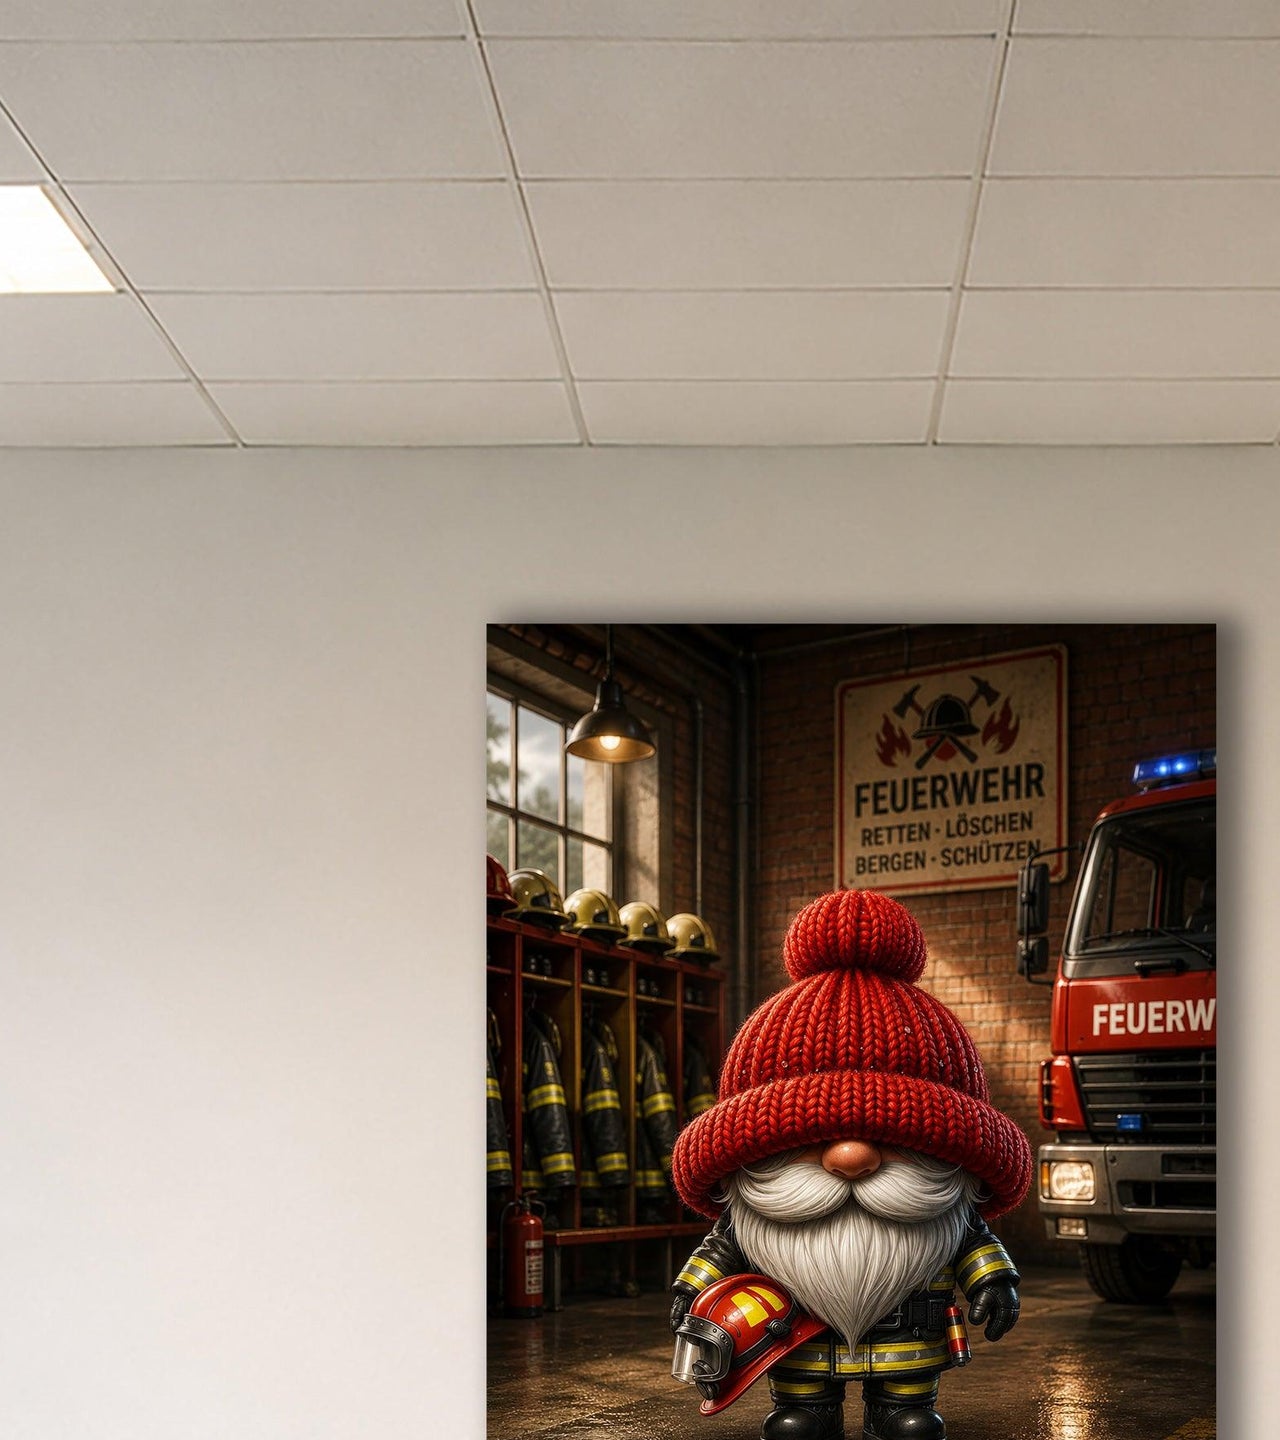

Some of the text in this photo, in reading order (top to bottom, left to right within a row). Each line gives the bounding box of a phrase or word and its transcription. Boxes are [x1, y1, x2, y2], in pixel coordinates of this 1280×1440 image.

[854, 762, 1046, 818] FEUERWEHR
[861, 811, 1033, 847] RETTEN LÖSCHEN
[856, 839, 1041, 875] BERGEN SCHÜTZEN
